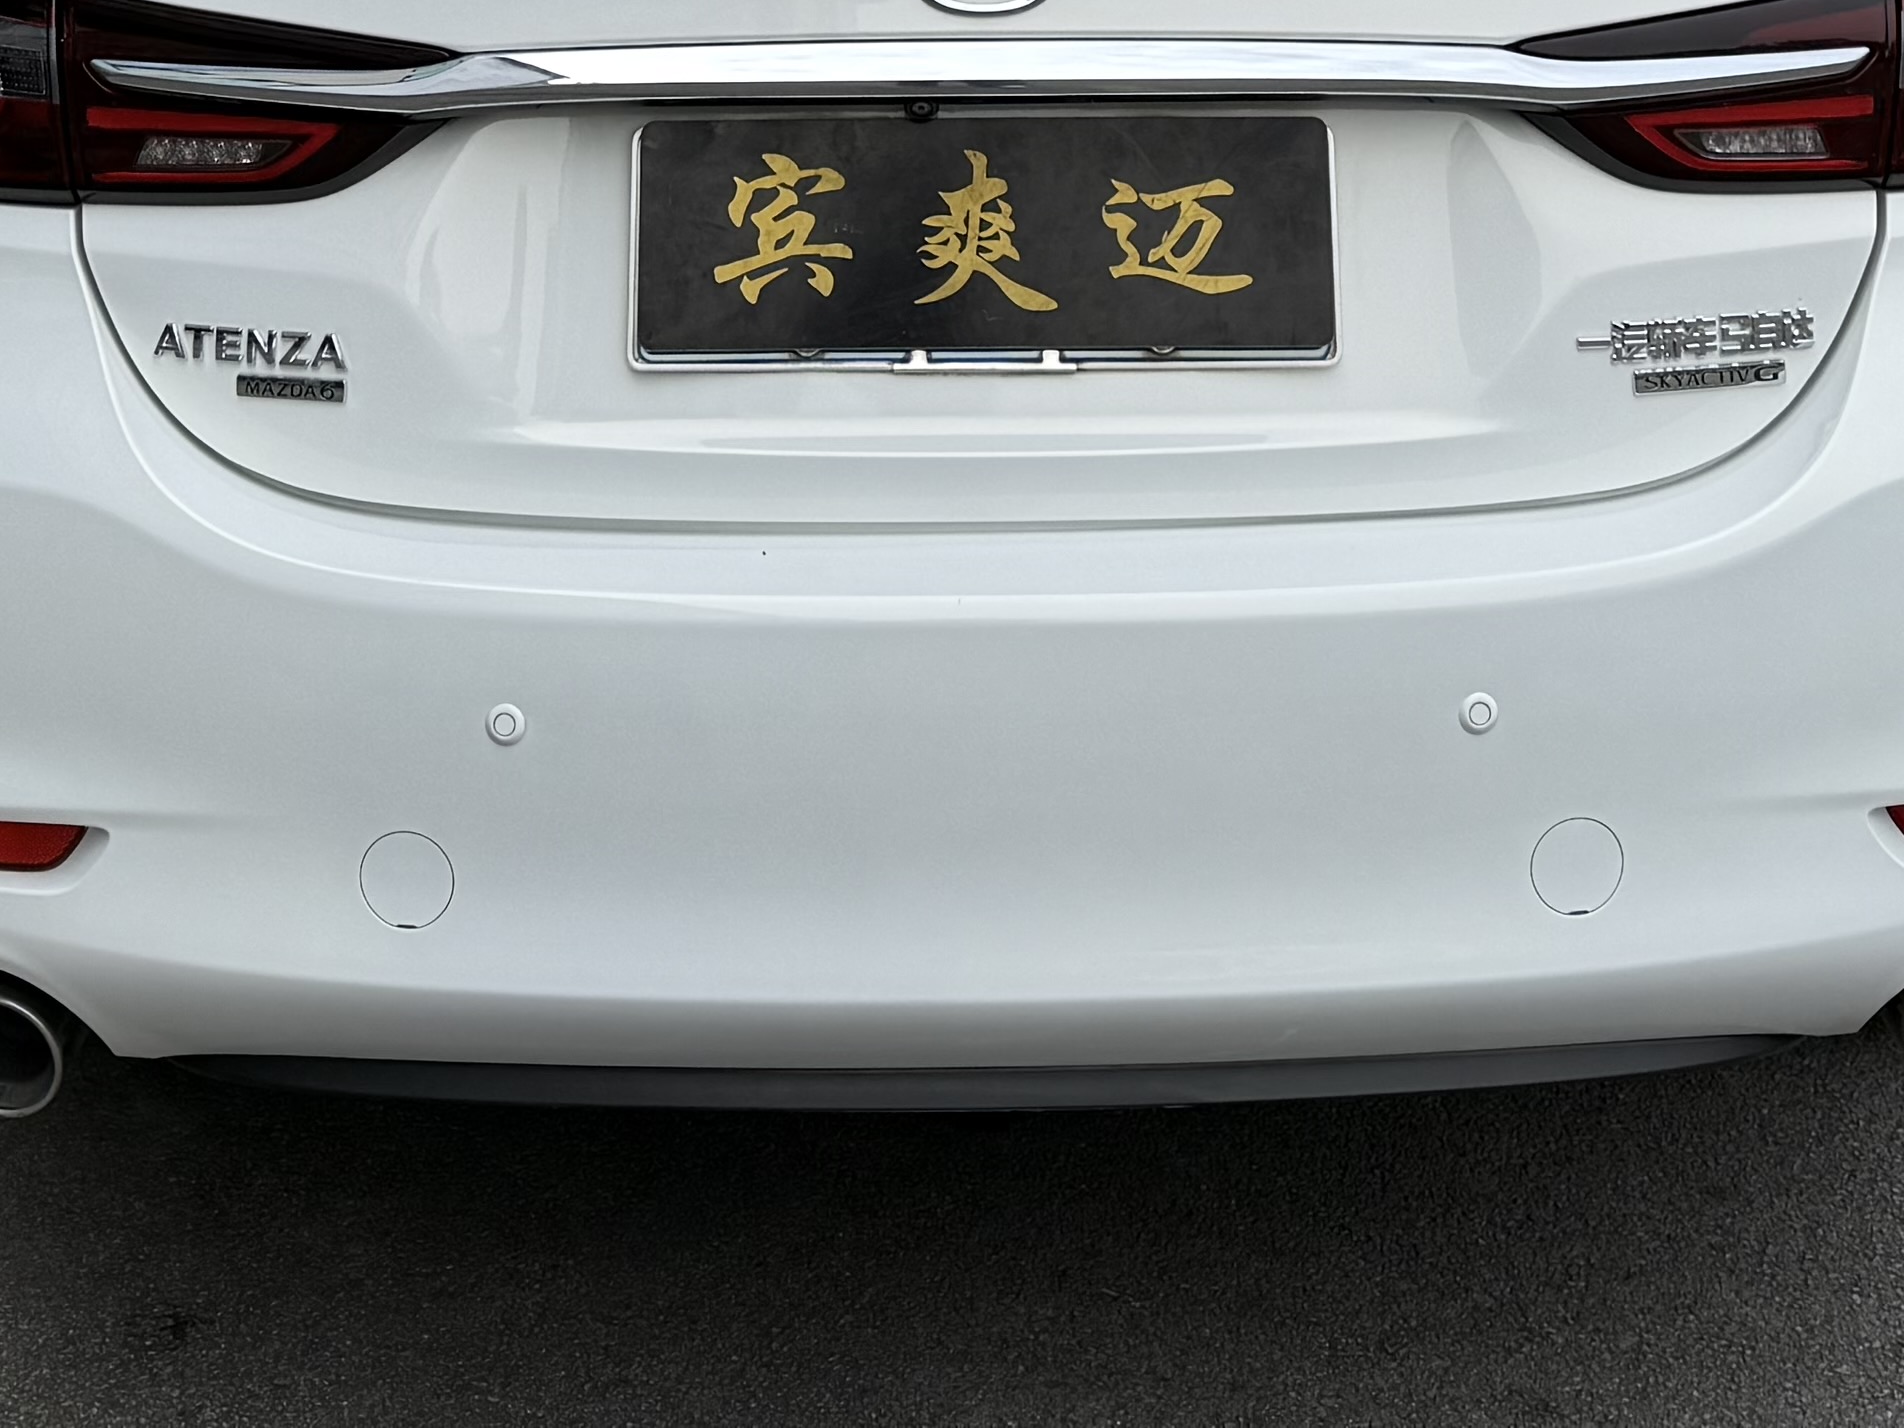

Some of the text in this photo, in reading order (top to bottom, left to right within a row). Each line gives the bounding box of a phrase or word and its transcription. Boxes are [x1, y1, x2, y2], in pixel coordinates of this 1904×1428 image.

[713, 149, 1254, 312] 宾爽迈
[152, 322, 348, 371] ATENZA
[1575, 306, 1816, 364] 一汽轿车马自达
